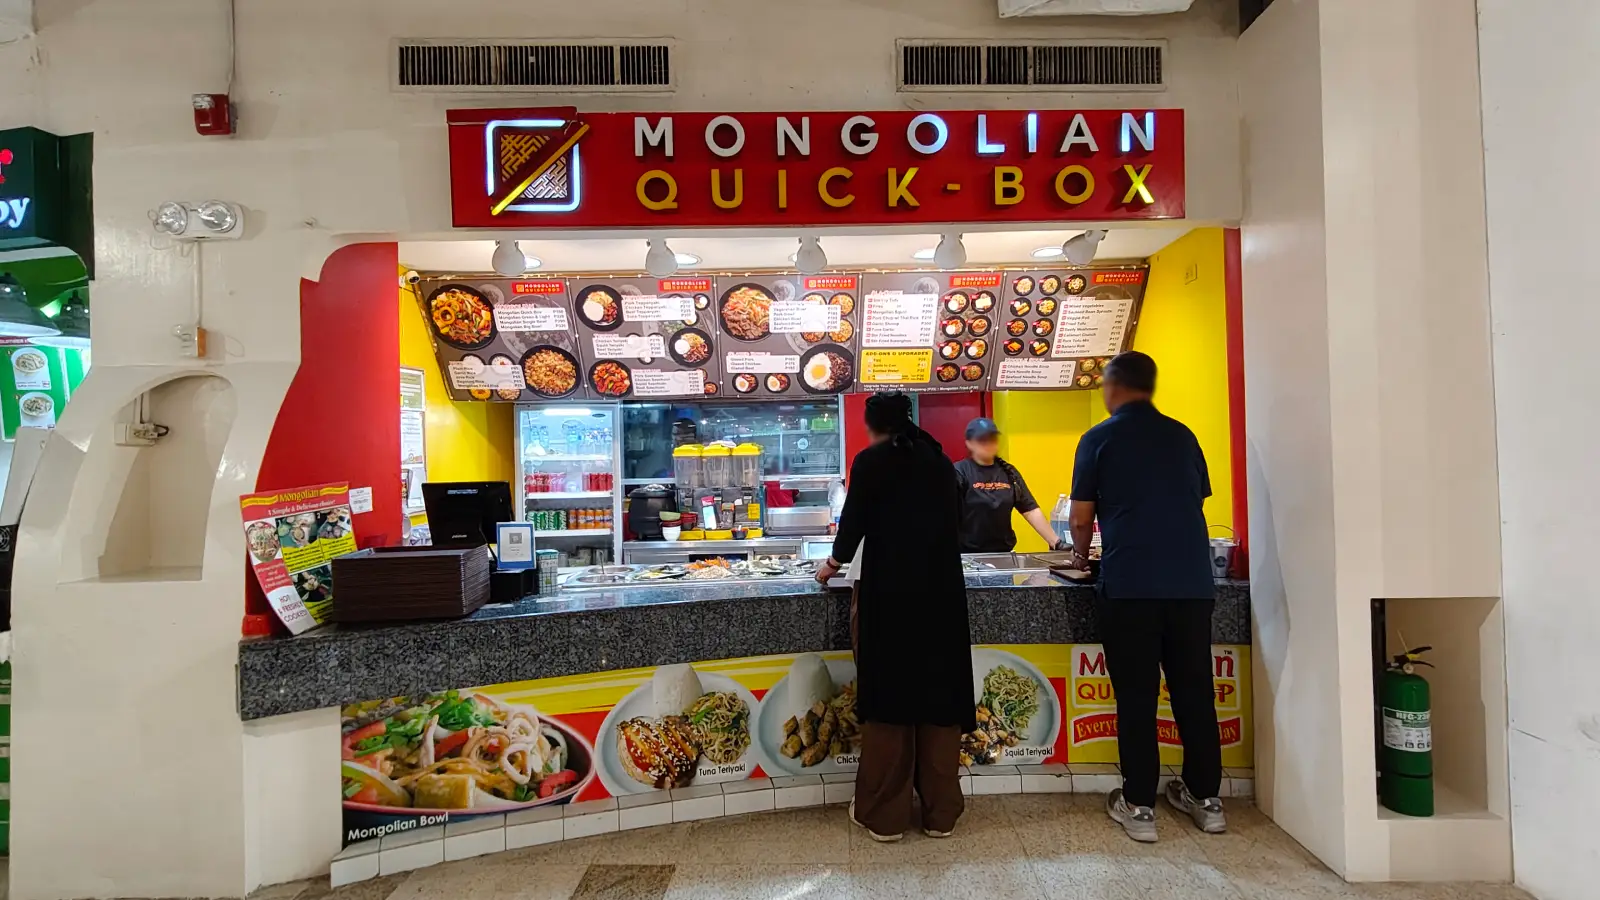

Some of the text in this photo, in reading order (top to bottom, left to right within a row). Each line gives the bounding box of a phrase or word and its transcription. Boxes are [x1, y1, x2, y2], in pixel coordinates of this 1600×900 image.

[634, 112, 1154, 157] MONGOLIAN
[279, 488, 320, 503] Mongolian
[1004, 746, 1053, 757] Squid Teriyaki
[698, 763, 746, 777] Tuna Teriyaki
[347, 811, 449, 842] Mongolian Bowl
